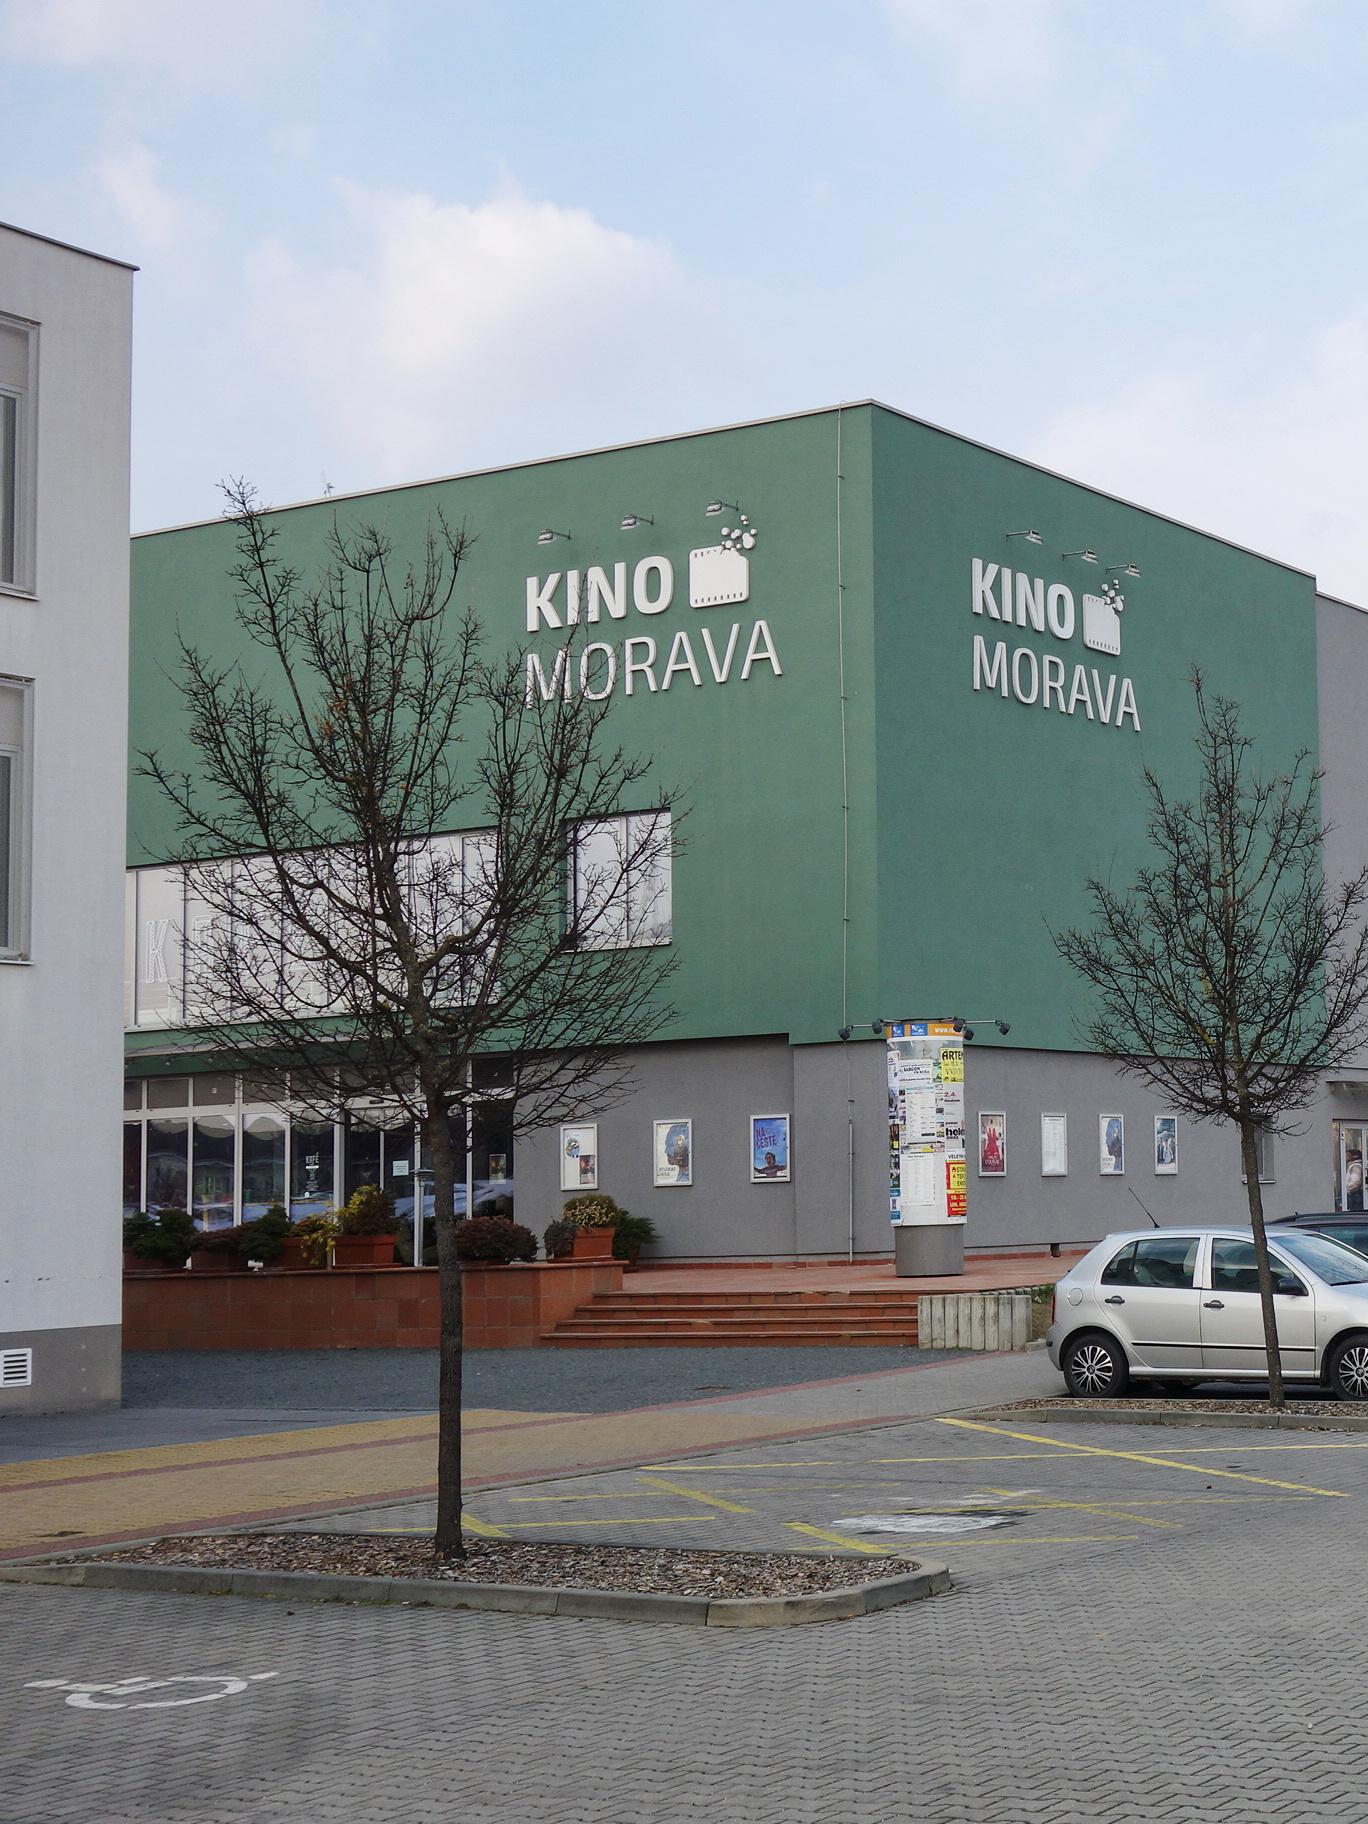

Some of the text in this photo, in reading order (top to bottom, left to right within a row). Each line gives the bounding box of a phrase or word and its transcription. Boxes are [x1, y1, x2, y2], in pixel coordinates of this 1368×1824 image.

[525, 555, 675, 632] KINO
[970, 557, 1075, 640] KINO
[525, 619, 783, 710] MORAVA
[972, 634, 1142, 732] MORAVA
